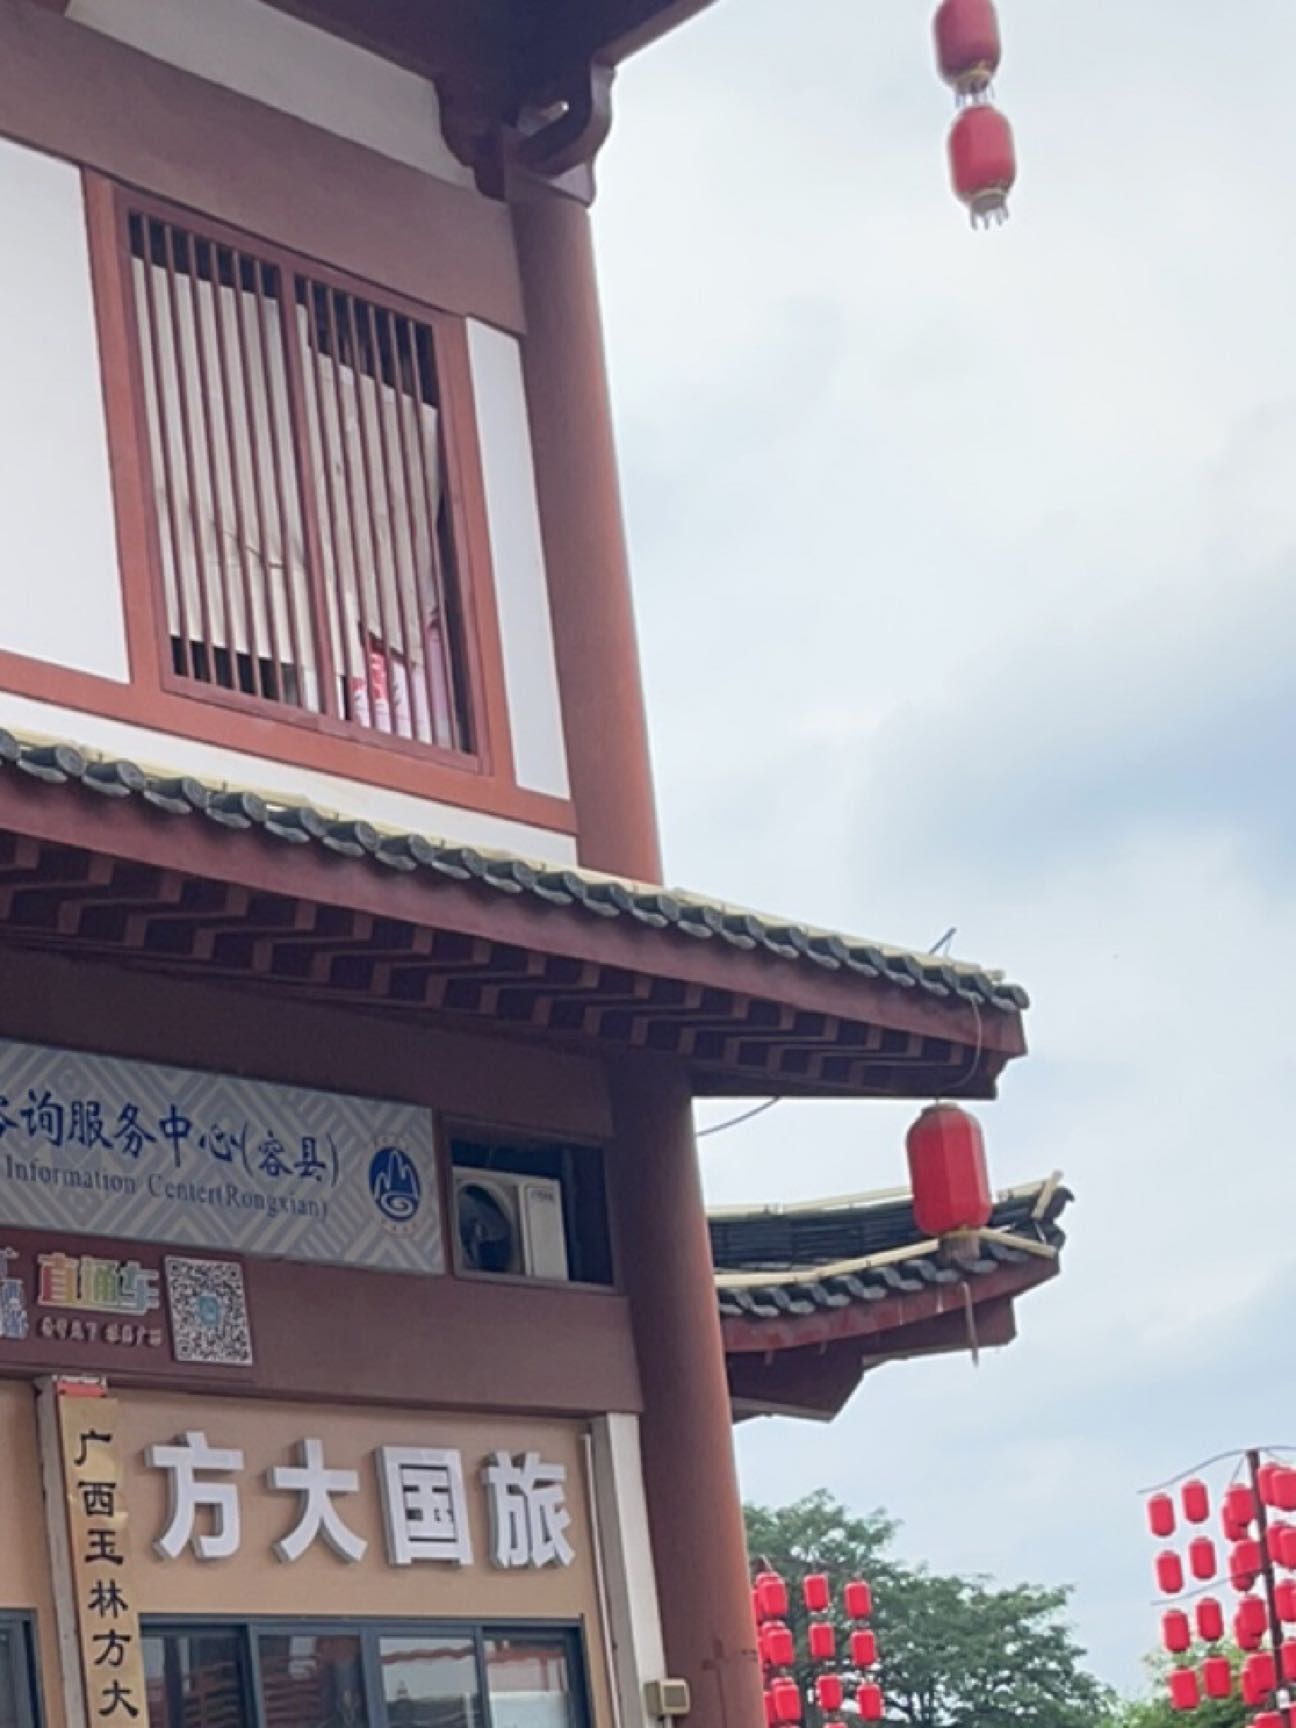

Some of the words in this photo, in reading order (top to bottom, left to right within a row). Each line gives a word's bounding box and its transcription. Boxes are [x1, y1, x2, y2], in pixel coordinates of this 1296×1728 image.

[6, 1154, 136, 1194] Information
[37, 1252, 160, 1316] 直通车
[145, 1430, 575, 1569] 方大国旅
